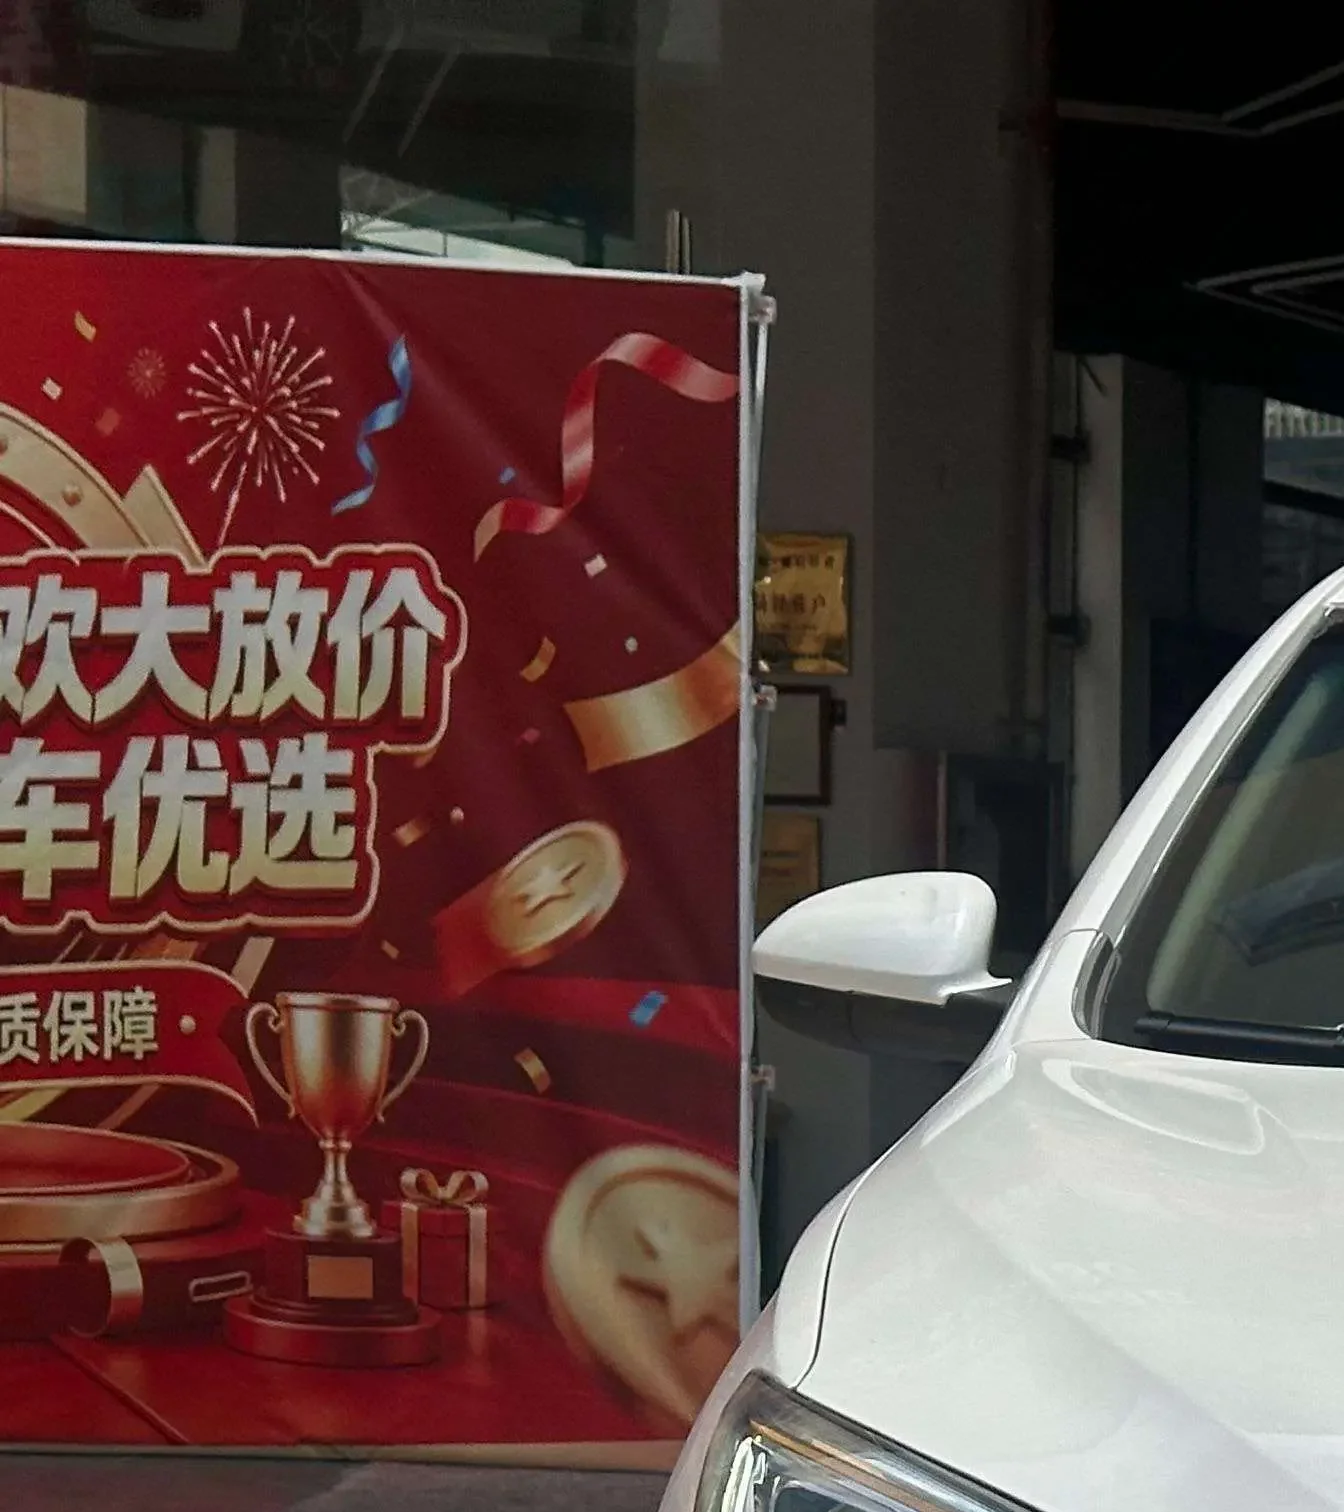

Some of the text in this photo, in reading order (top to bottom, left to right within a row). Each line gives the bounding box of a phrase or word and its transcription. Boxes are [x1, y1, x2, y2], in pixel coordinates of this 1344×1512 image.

[0, 567, 446, 726] 欢大放价
[0, 732, 358, 901] 车优选
[0, 986, 158, 1063] 质保障
